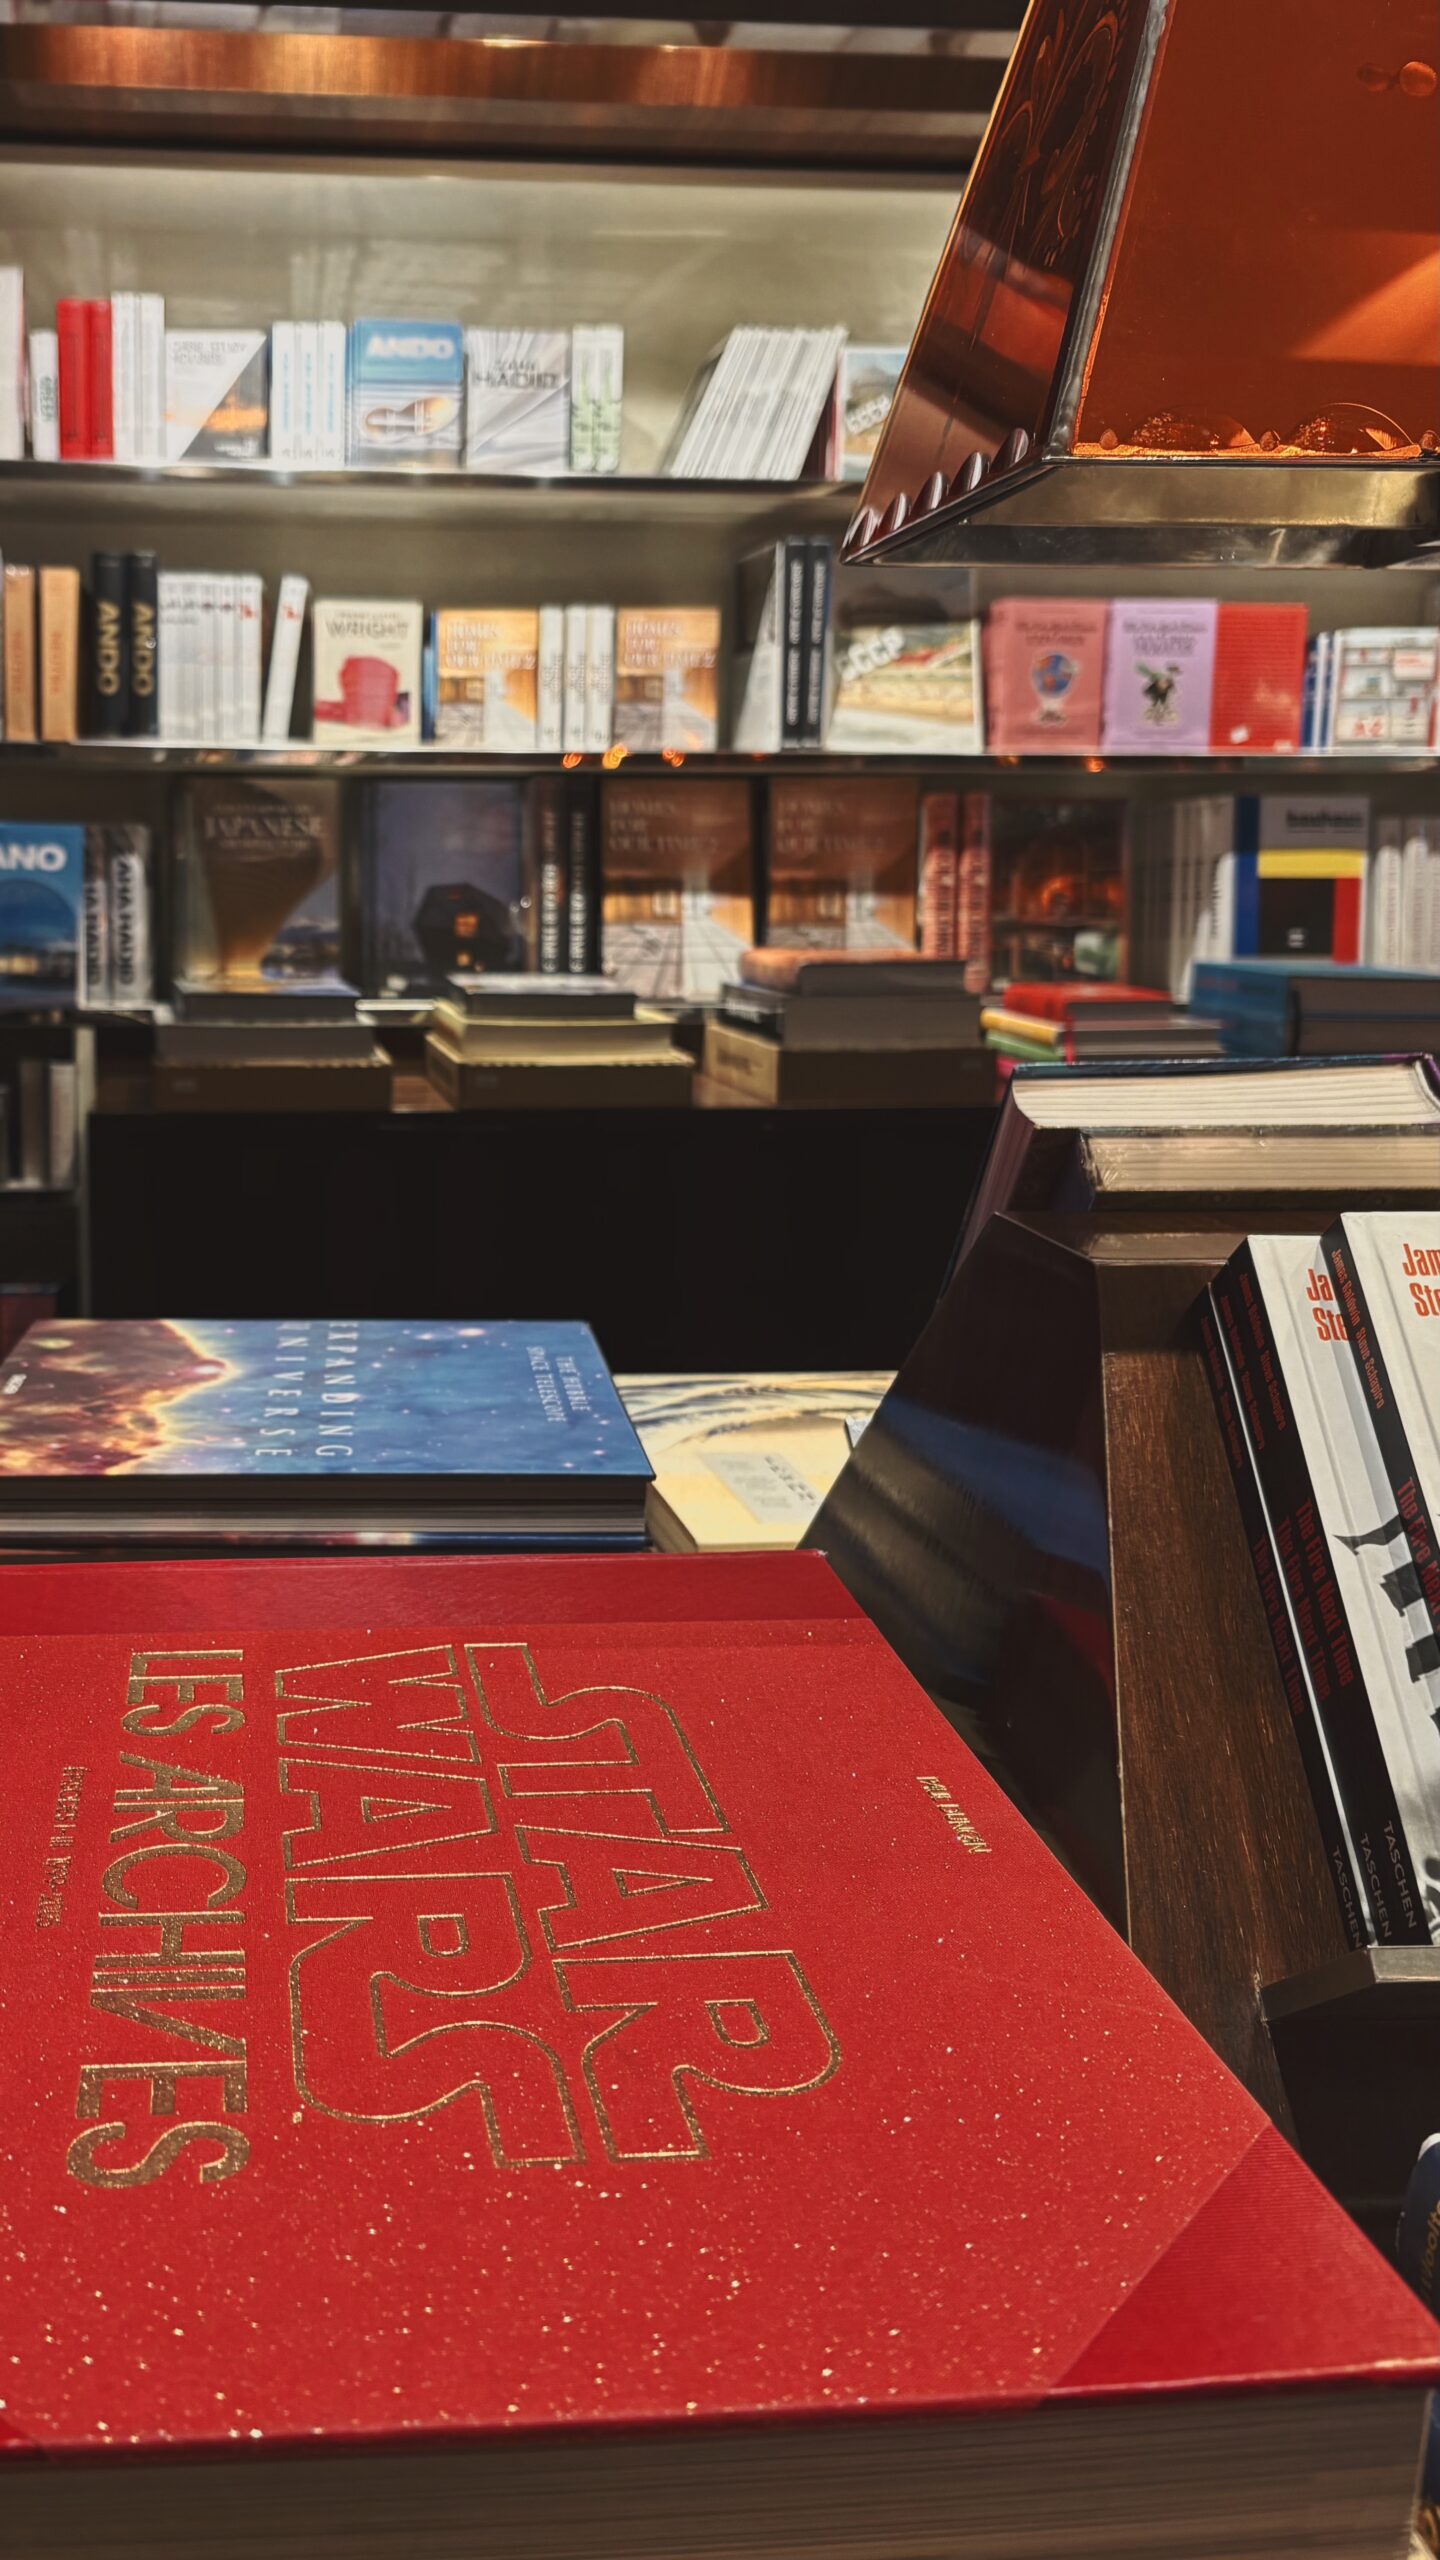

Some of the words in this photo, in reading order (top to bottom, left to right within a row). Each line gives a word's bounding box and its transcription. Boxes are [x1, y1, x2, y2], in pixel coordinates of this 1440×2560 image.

[364, 337, 455, 360] ANDO
[100, 603, 119, 696] ANDO
[132, 603, 153, 696] ANDO
[204, 816, 323, 838] JAPANESE
[1287, 809, 1363, 827] bauhaus
[1331, 1248, 1348, 1285] James
[1342, 1281, 1361, 1327] Baldwin
[1355, 1327, 1371, 1361] Steve
[1365, 1357, 1385, 1410] Schapiro
[255, 1322, 310, 1457] UNIVERSE
[315, 1321, 359, 1457] EXPANDING
[533, 1373, 567, 1422] TELESCOPE
[1296, 1498, 1315, 1541] The
[1305, 1536, 1327, 1583] Fire
[1397, 1476, 1418, 1521] The
[1408, 1515, 1432, 1565] Fire
[1317, 1579, 1342, 1635] Next
[119, 1649, 245, 1737] LES
[1331, 1632, 1354, 1688] Time
[274, 1644, 586, 2168] WARS
[463, 1642, 842, 2163] STAR
[1332, 1845, 1362, 1949] TASCHEN
[1360, 1832, 1392, 1938] TASCHEN
[1383, 1820, 1417, 1929] TASCHEN
[65, 1751, 250, 2188] ARCHIVES
